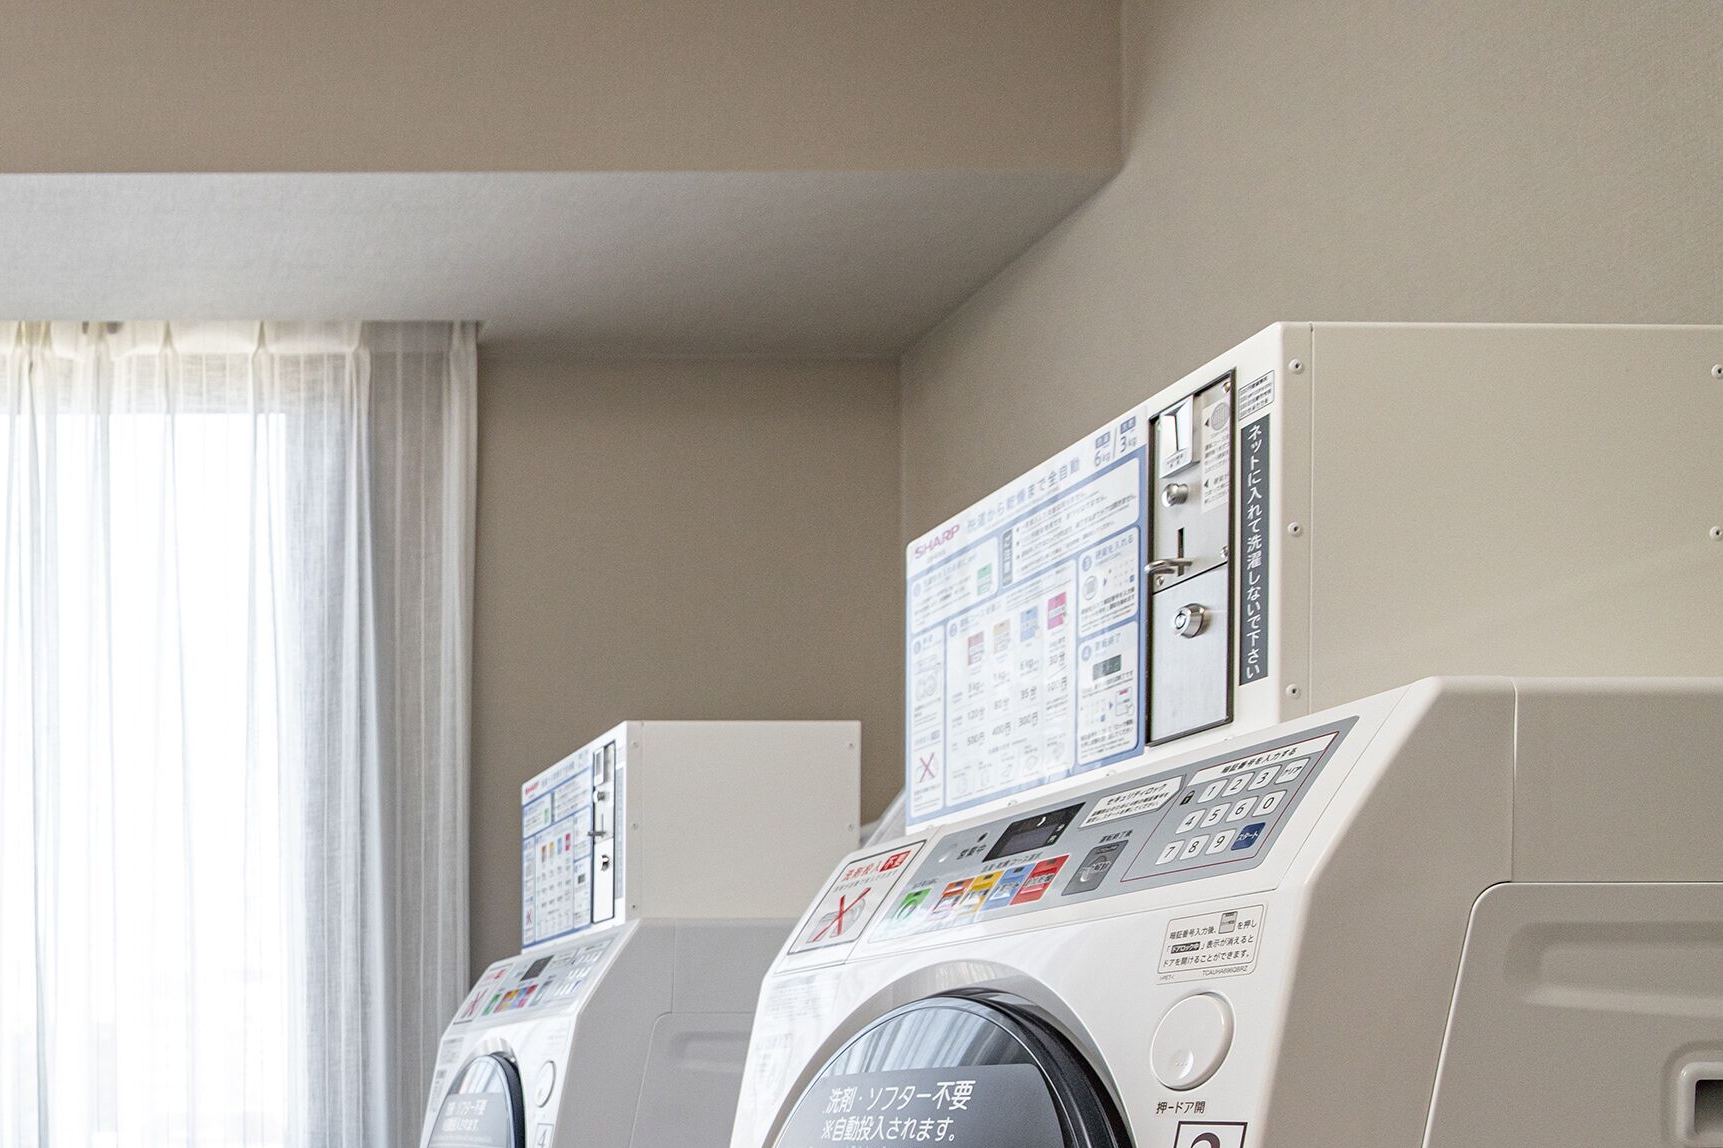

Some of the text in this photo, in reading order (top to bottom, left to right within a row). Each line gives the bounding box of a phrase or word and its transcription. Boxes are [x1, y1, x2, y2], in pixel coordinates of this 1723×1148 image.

[914, 524, 961, 560] SHARP
[1246, 424, 1264, 681] ネットに入れて洗濯しないで下さい
[1221, 747, 1298, 774] 暗証番号を入力する
[1230, 778, 1243, 791] 2
[1256, 771, 1269, 785] 3
[1284, 766, 1303, 777] クリア
[1184, 796, 1275, 827] 4 5 6 0
[1164, 831, 1259, 859] 7 8 9 スタート
[1236, 919, 1258, 931] を押し
[1163, 949, 1250, 968] ドアを開けることができます。
[824, 1079, 977, 1115] 洗剤・ソフター不要
[820, 1116, 958, 1143] ※自動投入されます。
